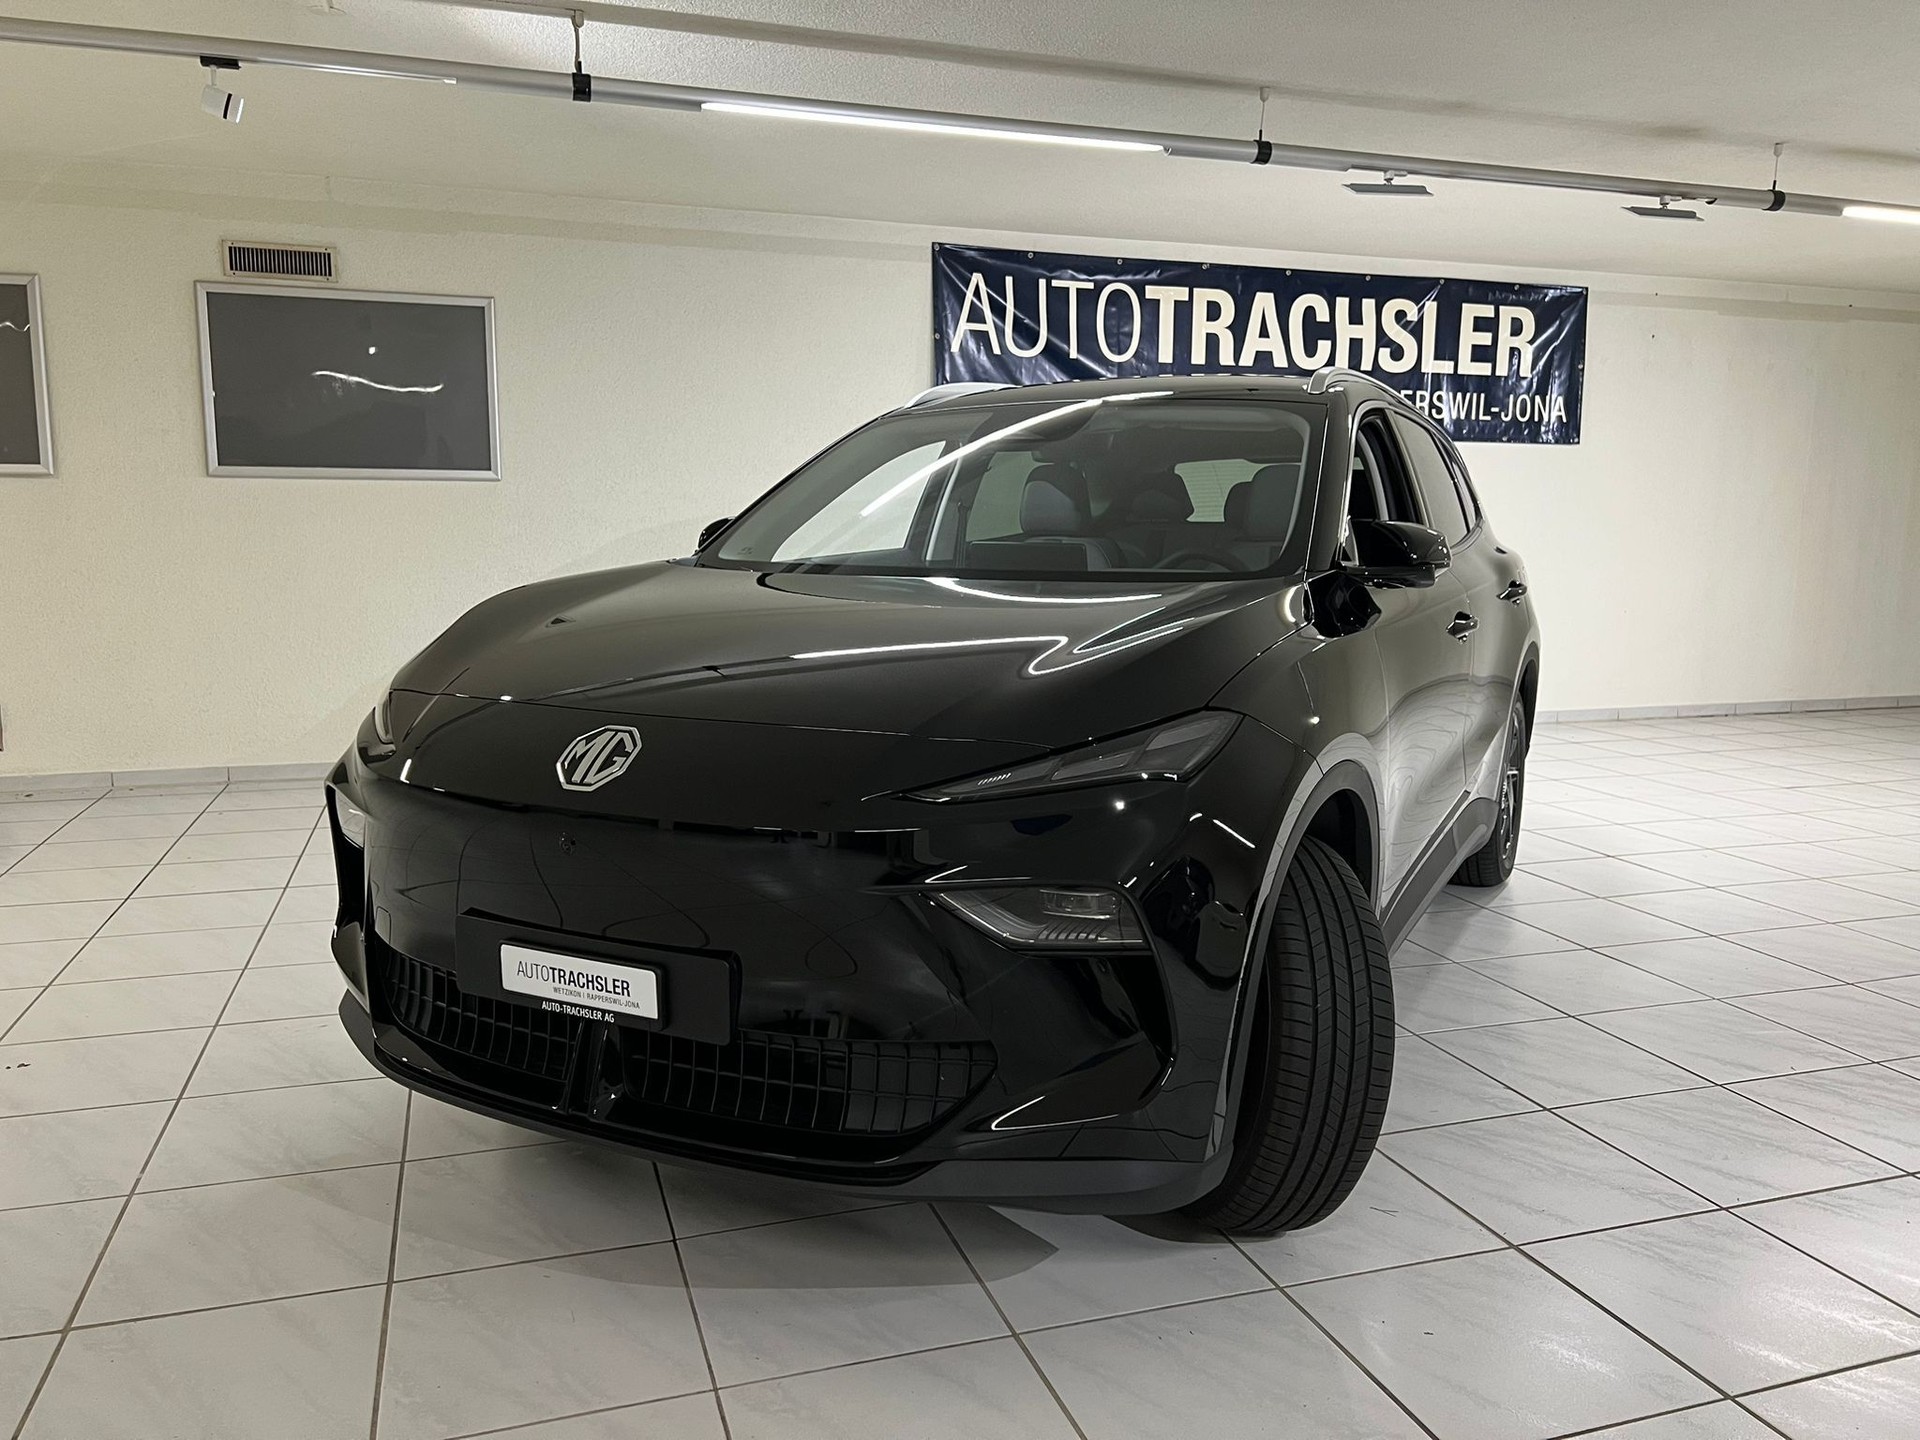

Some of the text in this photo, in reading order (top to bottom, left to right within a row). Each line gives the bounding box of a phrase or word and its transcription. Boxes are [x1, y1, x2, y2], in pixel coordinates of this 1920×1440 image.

[950, 271, 1536, 378] AUTOTRACHSLER
[563, 730, 635, 785] MG
[516, 960, 631, 997] AUTOTRACHSLER
[541, 1000, 615, 1023] AUTO-TRACHSLER AG
[553, 986, 582, 999] WETZIKON
[586, 992, 640, 1009] RAPPERSWIL-JONA
